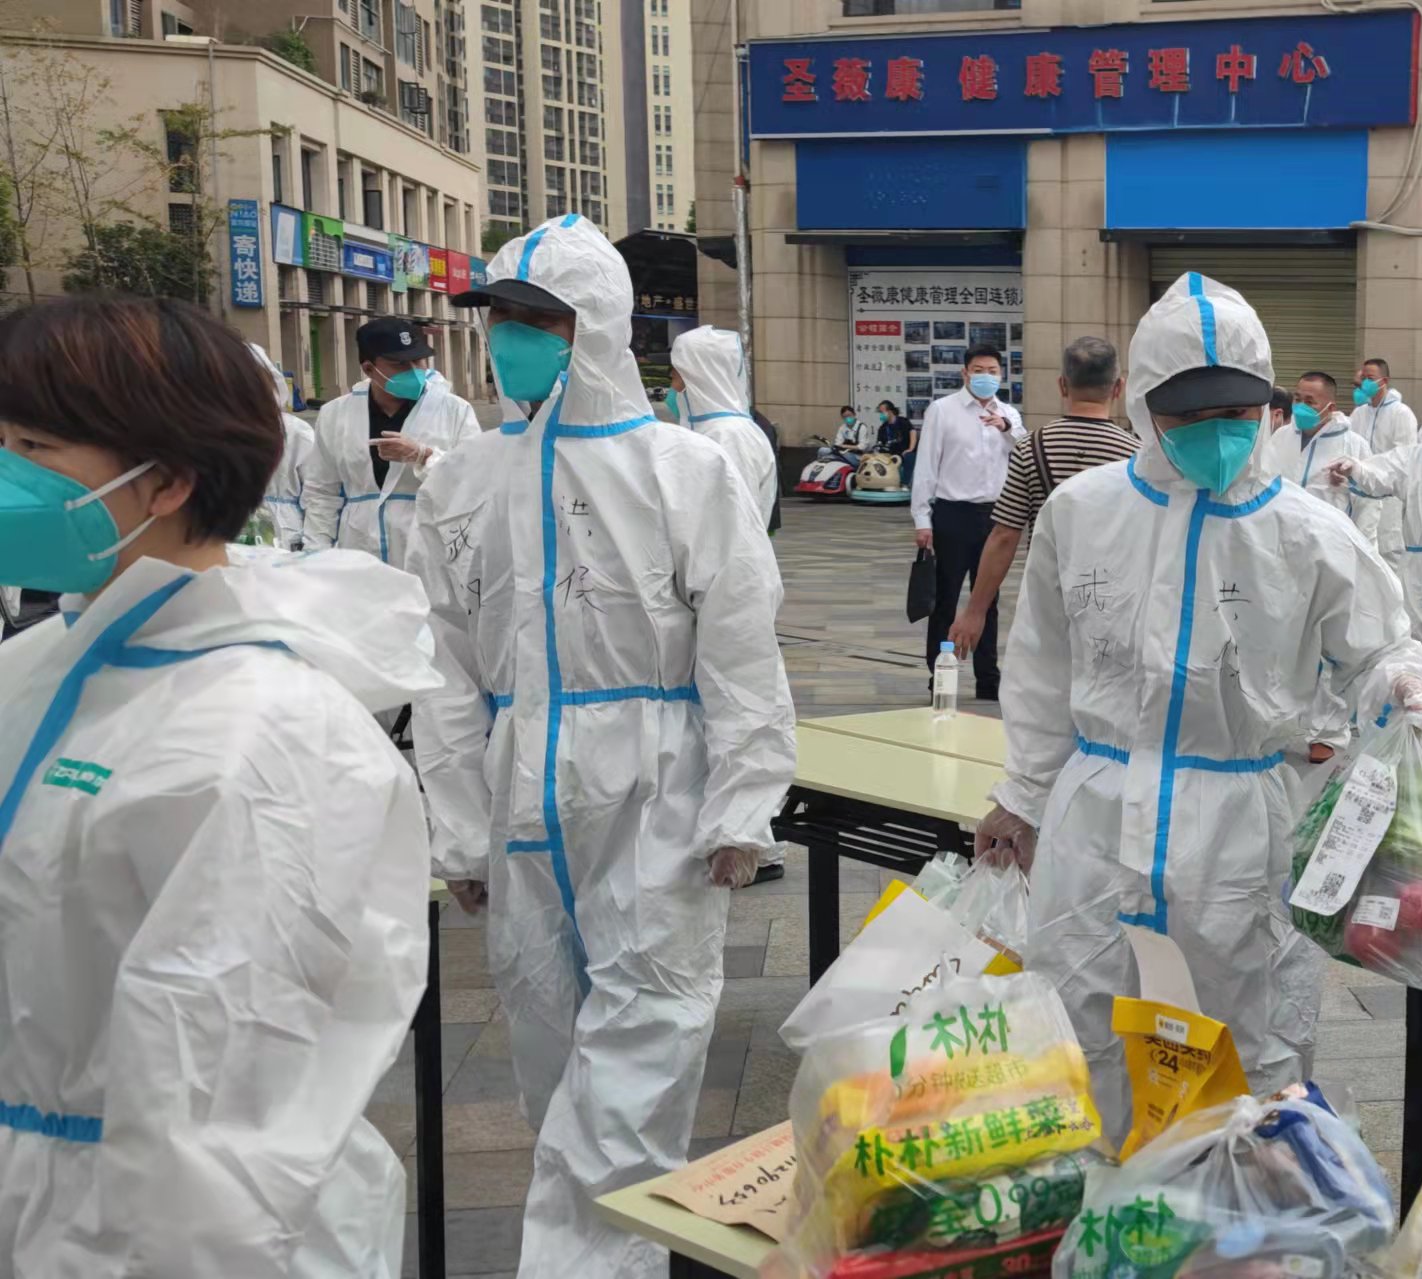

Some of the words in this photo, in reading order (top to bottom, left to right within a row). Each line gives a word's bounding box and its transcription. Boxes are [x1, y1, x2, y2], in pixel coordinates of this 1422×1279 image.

[232, 234, 260, 304] 寄快递
[856, 285, 1023, 306] 圣薇康健康管理全国连锁
